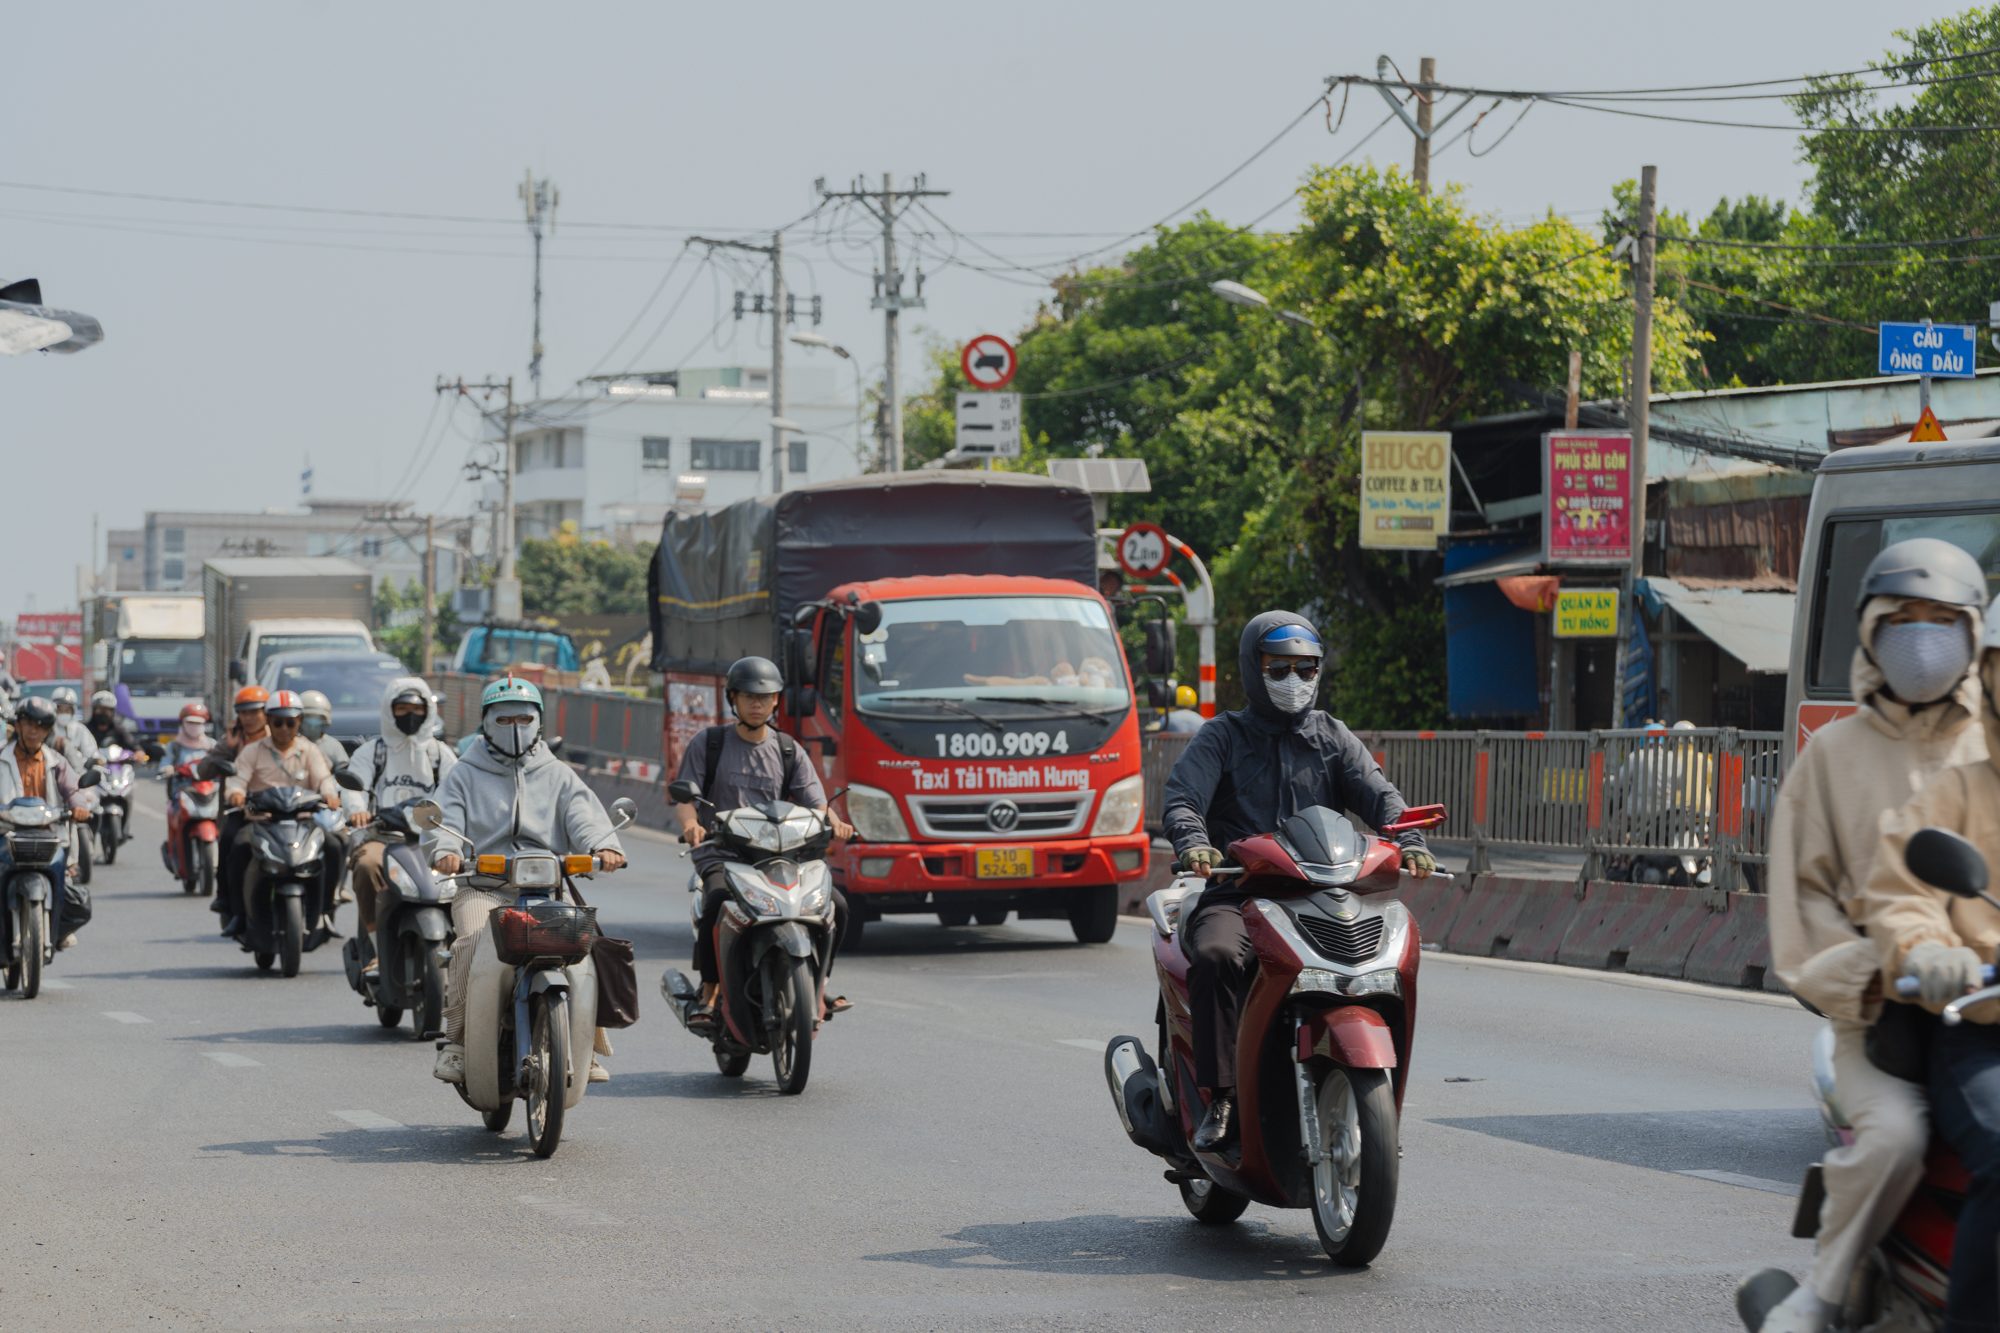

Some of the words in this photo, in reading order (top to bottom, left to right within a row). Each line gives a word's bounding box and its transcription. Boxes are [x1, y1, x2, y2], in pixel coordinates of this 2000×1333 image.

[1912, 325, 1943, 349] CẦU
[1890, 347, 1923, 370] ÔNG
[1932, 349, 1964, 372] DẦU
[1367, 442, 1445, 471] HUGO
[1583, 449, 1602, 471] SÀI
[1604, 449, 1627, 471] GÒN
[1365, 476, 1407, 493] COFFEE
[1411, 478, 1419, 492] &
[1423, 477, 1444, 493] TEA
[1563, 474, 1573, 489] 3
[1592, 474, 1604, 488] 11
[1561, 594, 1592, 612] QUÁN
[935, 730, 1069, 757] 1800.9094
[877, 759, 921, 769] THACO
[912, 767, 950, 790] Taxi
[955, 765, 983, 789] Tải
[986, 765, 1040, 788] Thành
[1044, 766, 1089, 790] Hưng
